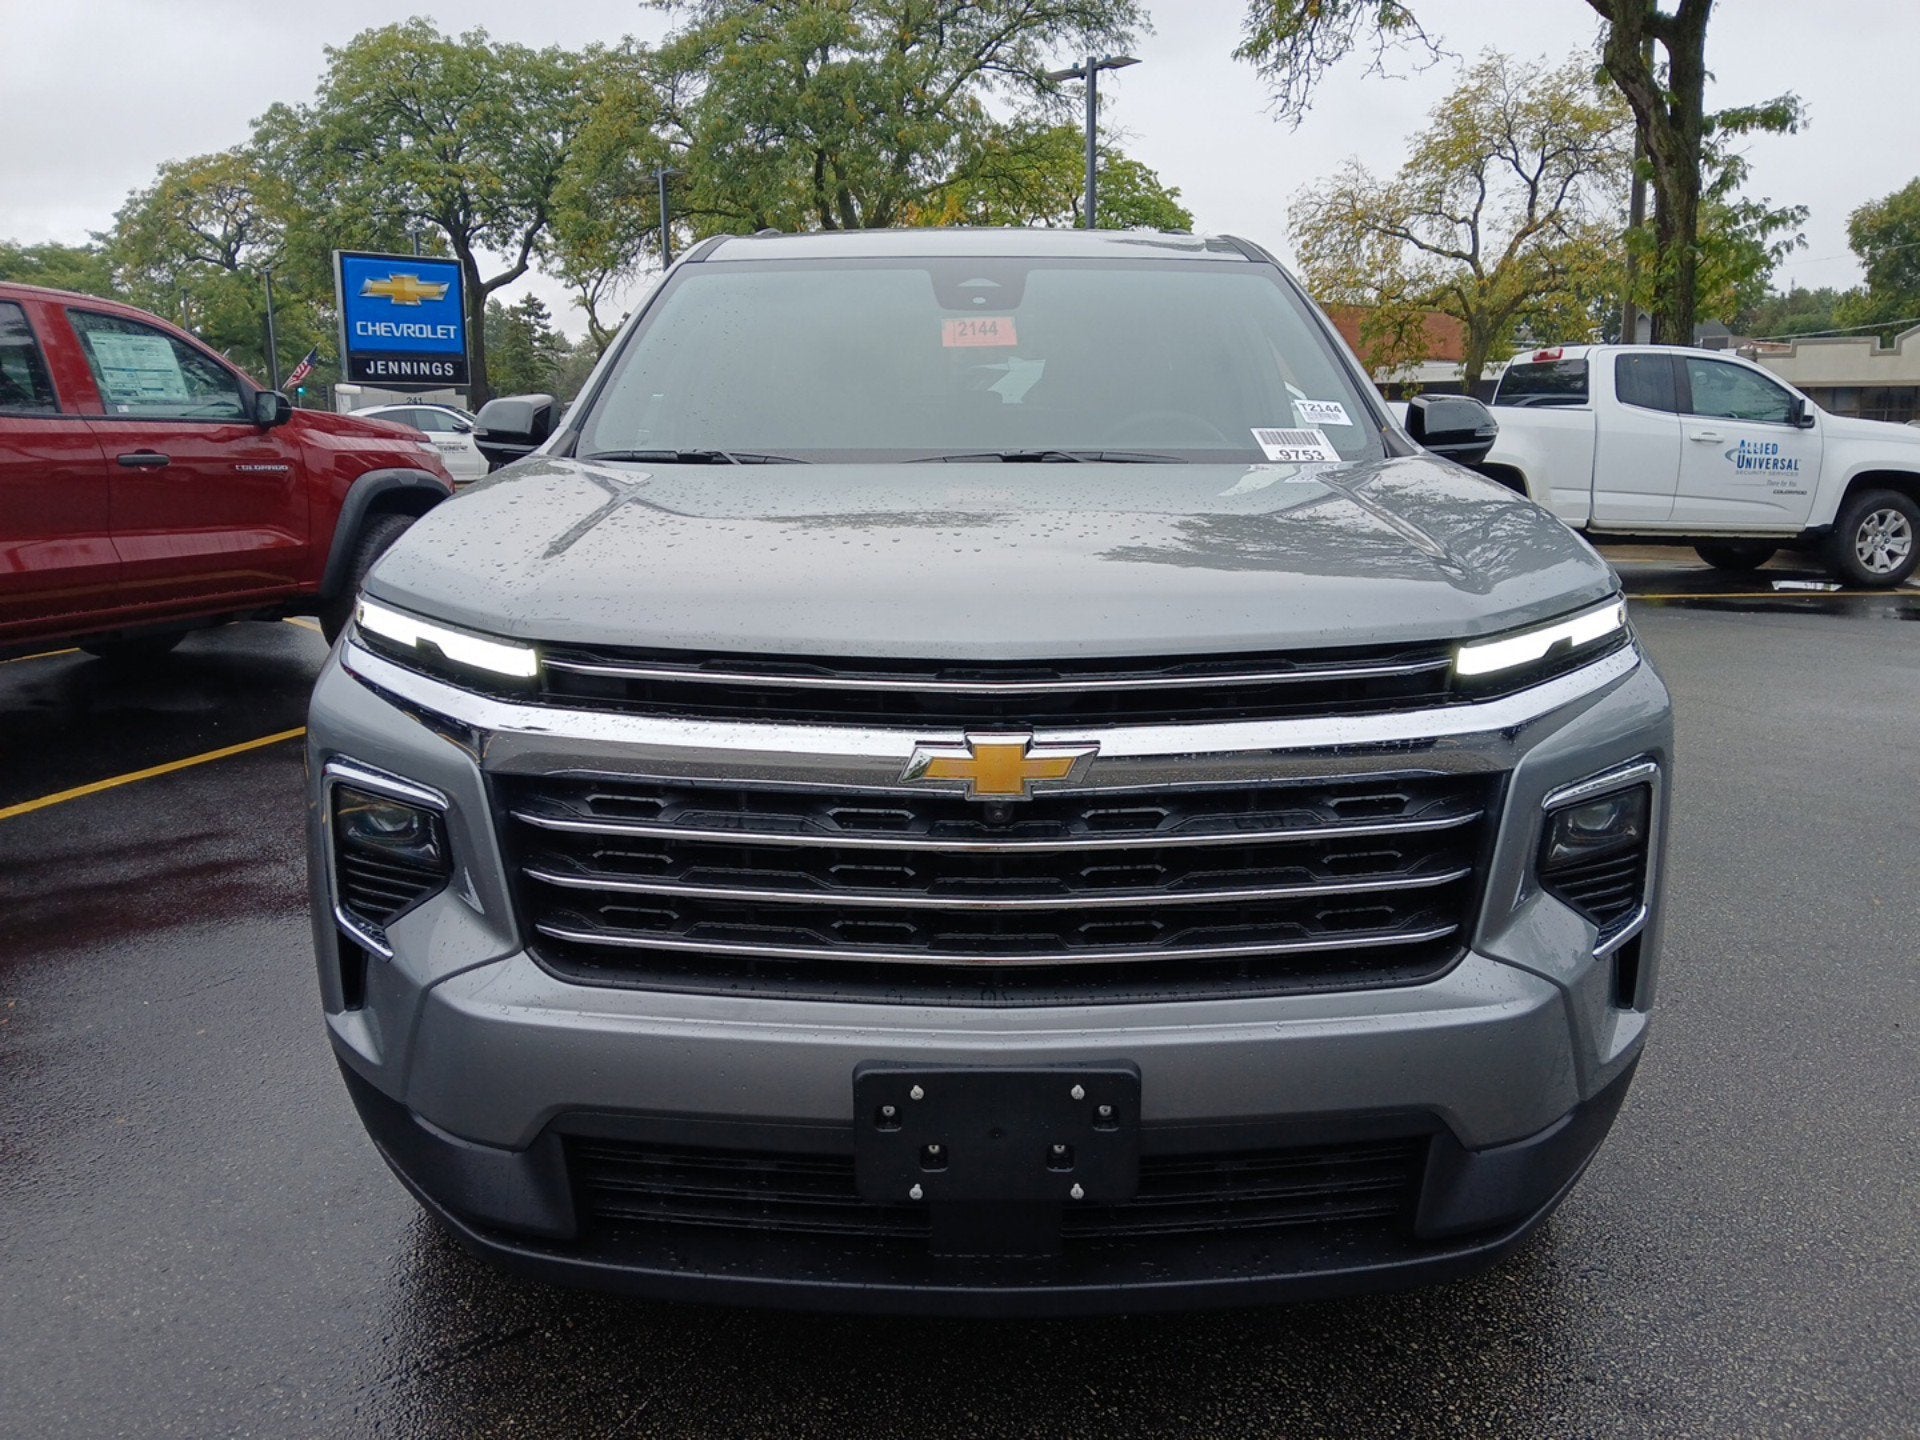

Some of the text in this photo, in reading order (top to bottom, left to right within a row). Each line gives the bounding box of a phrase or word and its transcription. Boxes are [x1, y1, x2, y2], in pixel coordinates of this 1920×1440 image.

[355, 320, 458, 340] CHEVROLET
[958, 320, 999, 337] 2144
[365, 360, 455, 377] JENNINGS
[1301, 403, 1342, 413] T2144
[1279, 448, 1326, 461] 9753
[1738, 439, 1779, 455] ALLIED
[1736, 454, 1800, 471] UNIVERSAL
